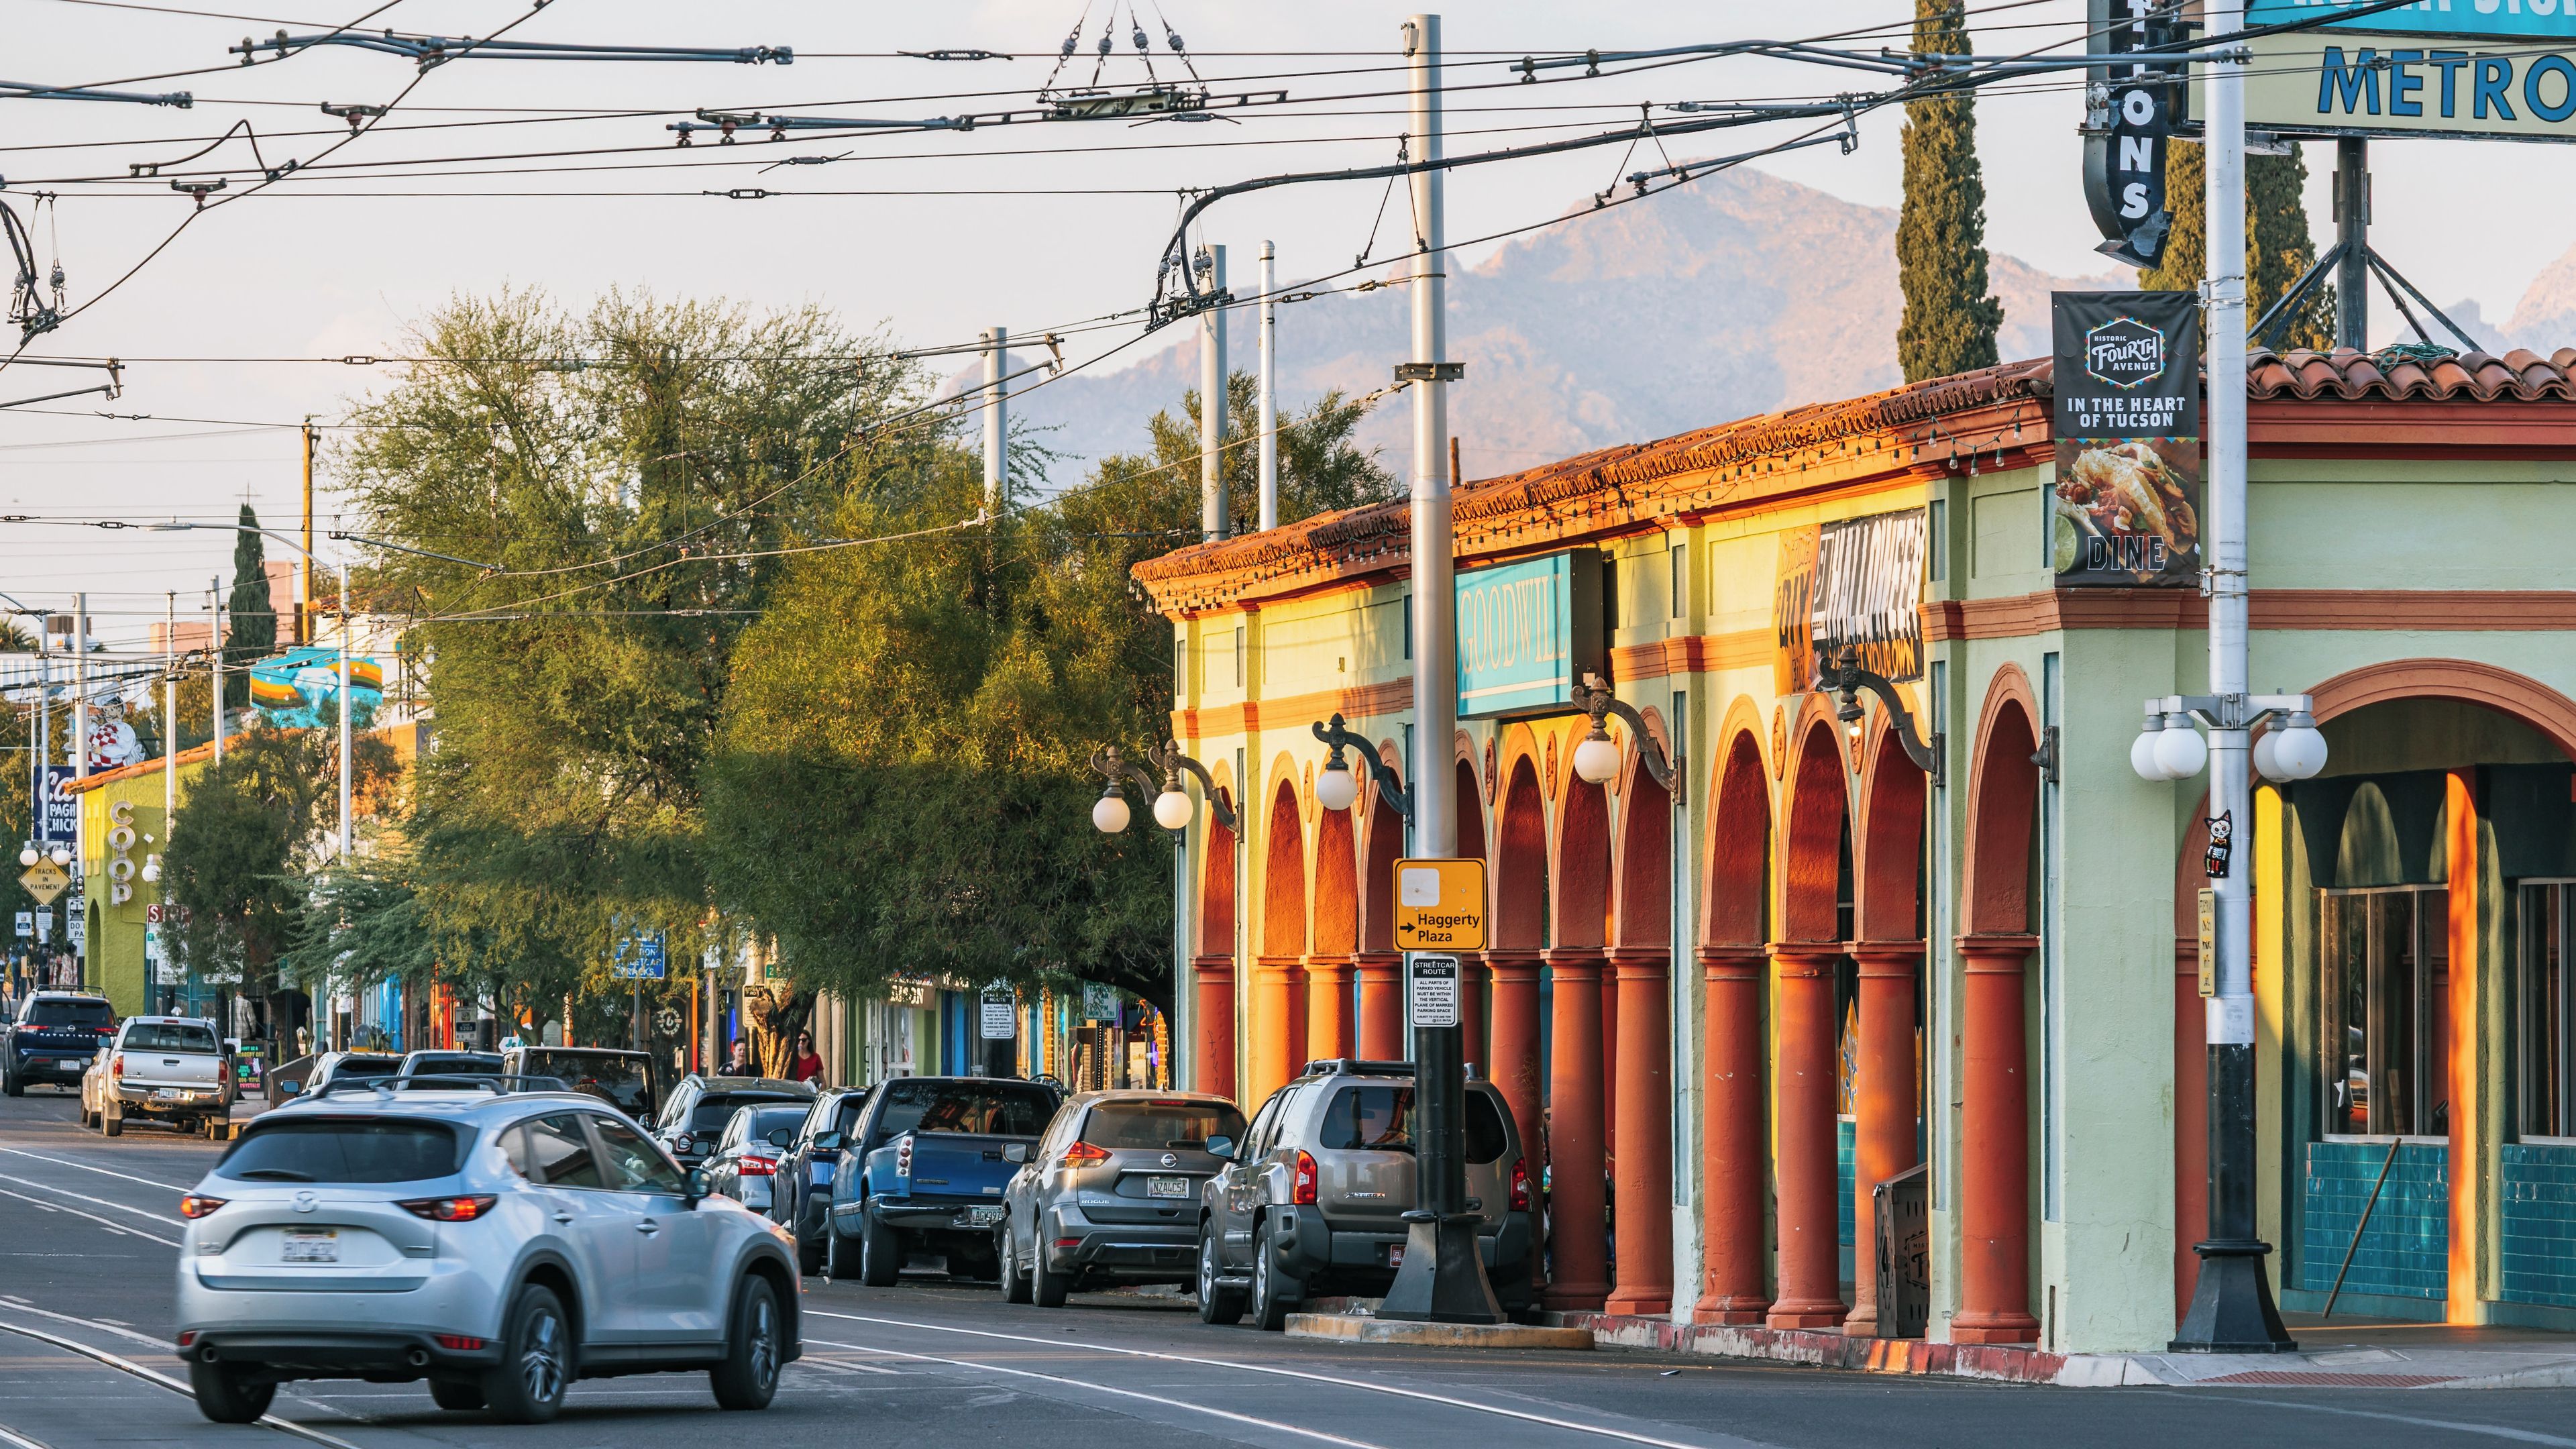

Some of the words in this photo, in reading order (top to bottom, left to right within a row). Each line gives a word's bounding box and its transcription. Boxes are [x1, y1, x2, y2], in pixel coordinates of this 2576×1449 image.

[2317, 46, 2576, 123] METRO
[2112, 362, 2156, 371] AVENUE
[2068, 398, 2086, 412] IN
[2092, 397, 2123, 412] THE
[2130, 396, 2186, 411] HEART
[2080, 413, 2100, 428] OF
[2106, 412, 2174, 427] TUCSON
[2087, 535, 2166, 571] DINE
[1459, 573, 1568, 675] GOODWILL
[108, 800, 136, 906] COOP
[1417, 913, 1480, 928] Haggerty
[1417, 930, 1452, 942] Plaza
[1153, 1182, 1187, 1193] NZA4C5A
